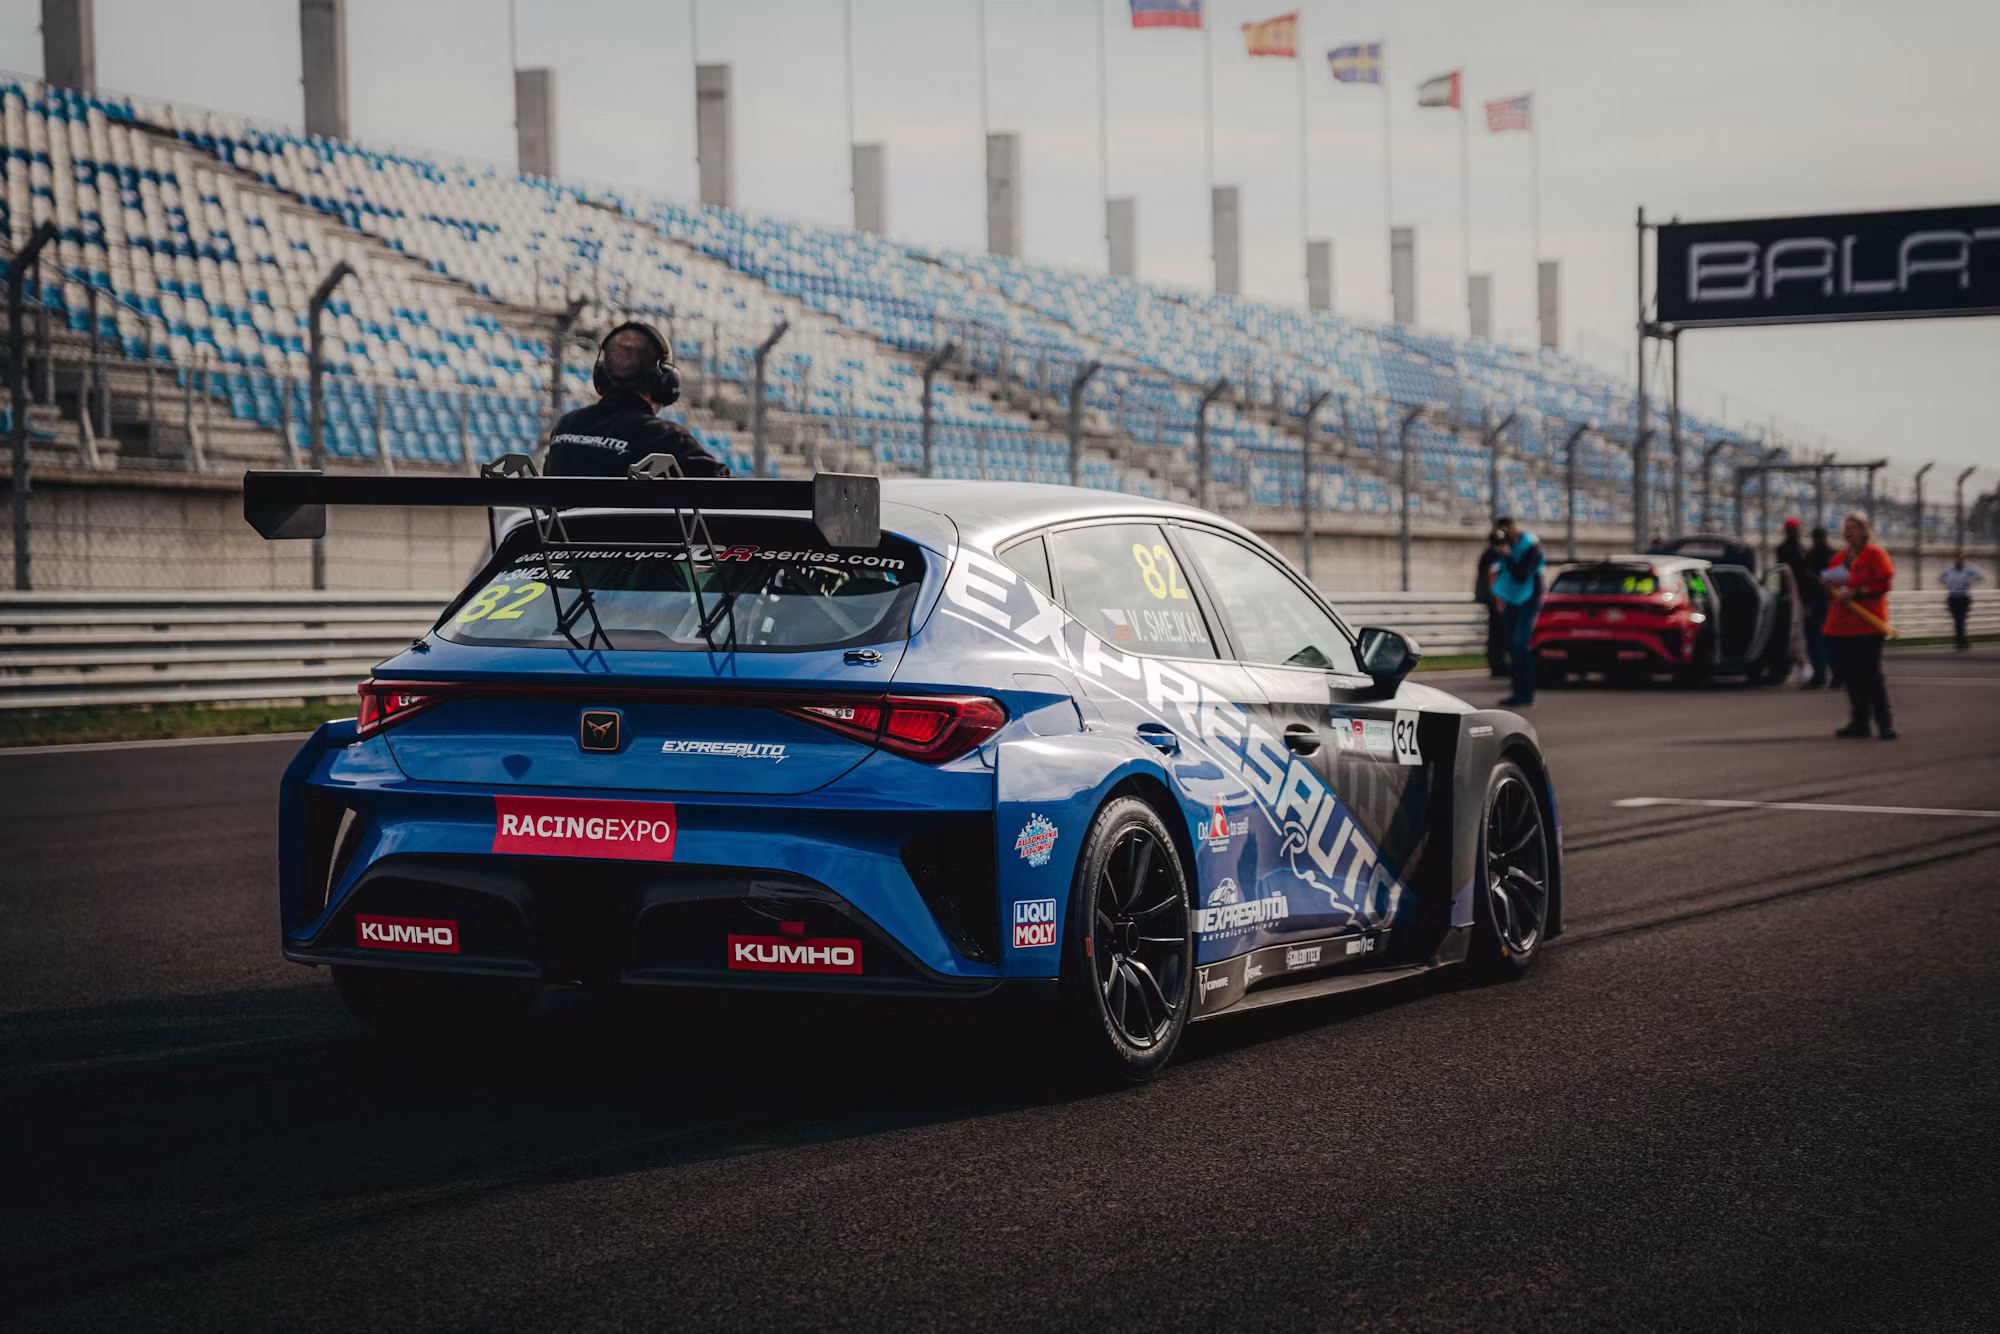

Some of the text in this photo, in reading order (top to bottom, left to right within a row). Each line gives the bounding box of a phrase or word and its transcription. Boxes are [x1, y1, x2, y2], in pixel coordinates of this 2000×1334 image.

[1687, 227, 2000, 302] BALA
[1132, 543, 1189, 599] 82
[455, 581, 547, 624] 82
[1126, 608, 1207, 643] V. SMEJKAL
[661, 740, 785, 756] EXPRESAUTO
[1397, 719, 1418, 755] 82
[502, 814, 670, 843] RACINGEXPO
[1016, 902, 1054, 923] LIQUI
[1203, 896, 1282, 934] EXPRESAUTO
[361, 922, 453, 945] KUMHO
[1015, 923, 1055, 945] MOLY
[735, 943, 855, 966] KUMHO
